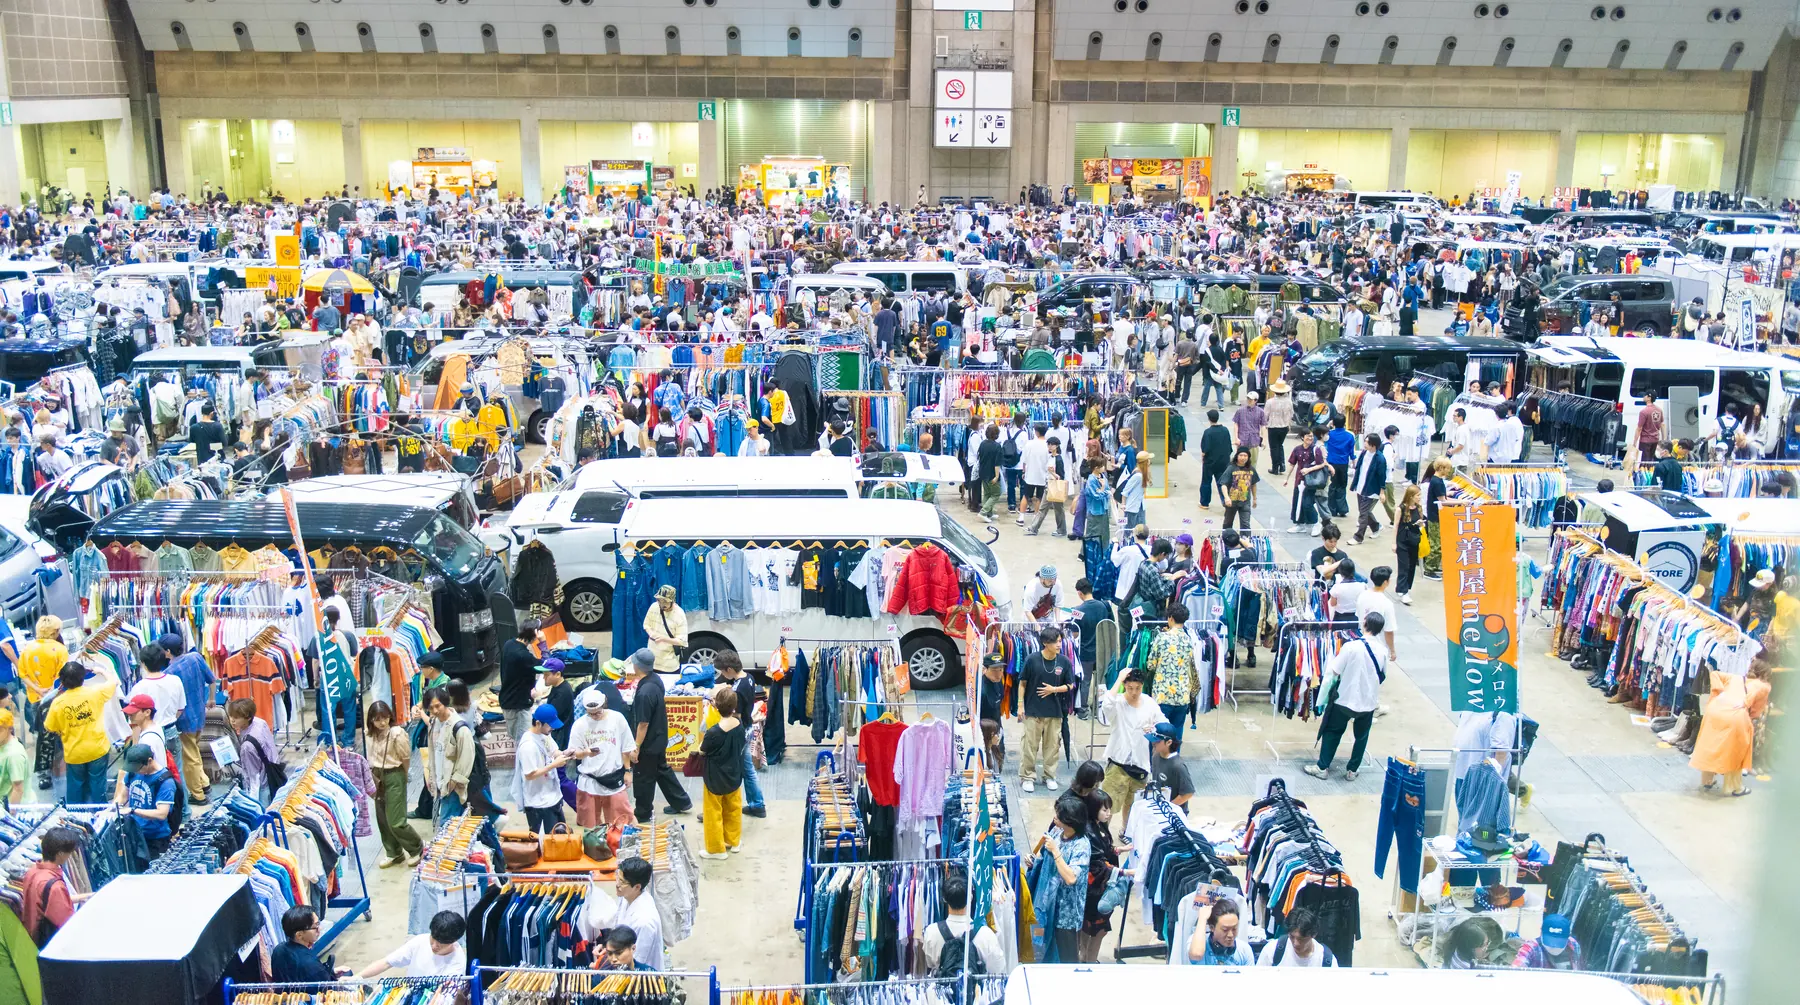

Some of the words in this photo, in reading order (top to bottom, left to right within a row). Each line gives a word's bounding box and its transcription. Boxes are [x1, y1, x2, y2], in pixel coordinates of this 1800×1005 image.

[669, 264, 701, 275] 50%
[704, 260, 733, 275] OFF
[775, 400, 784, 411] 23
[1461, 598, 1489, 710] mellow
[1491, 661, 1506, 709] メロウ
